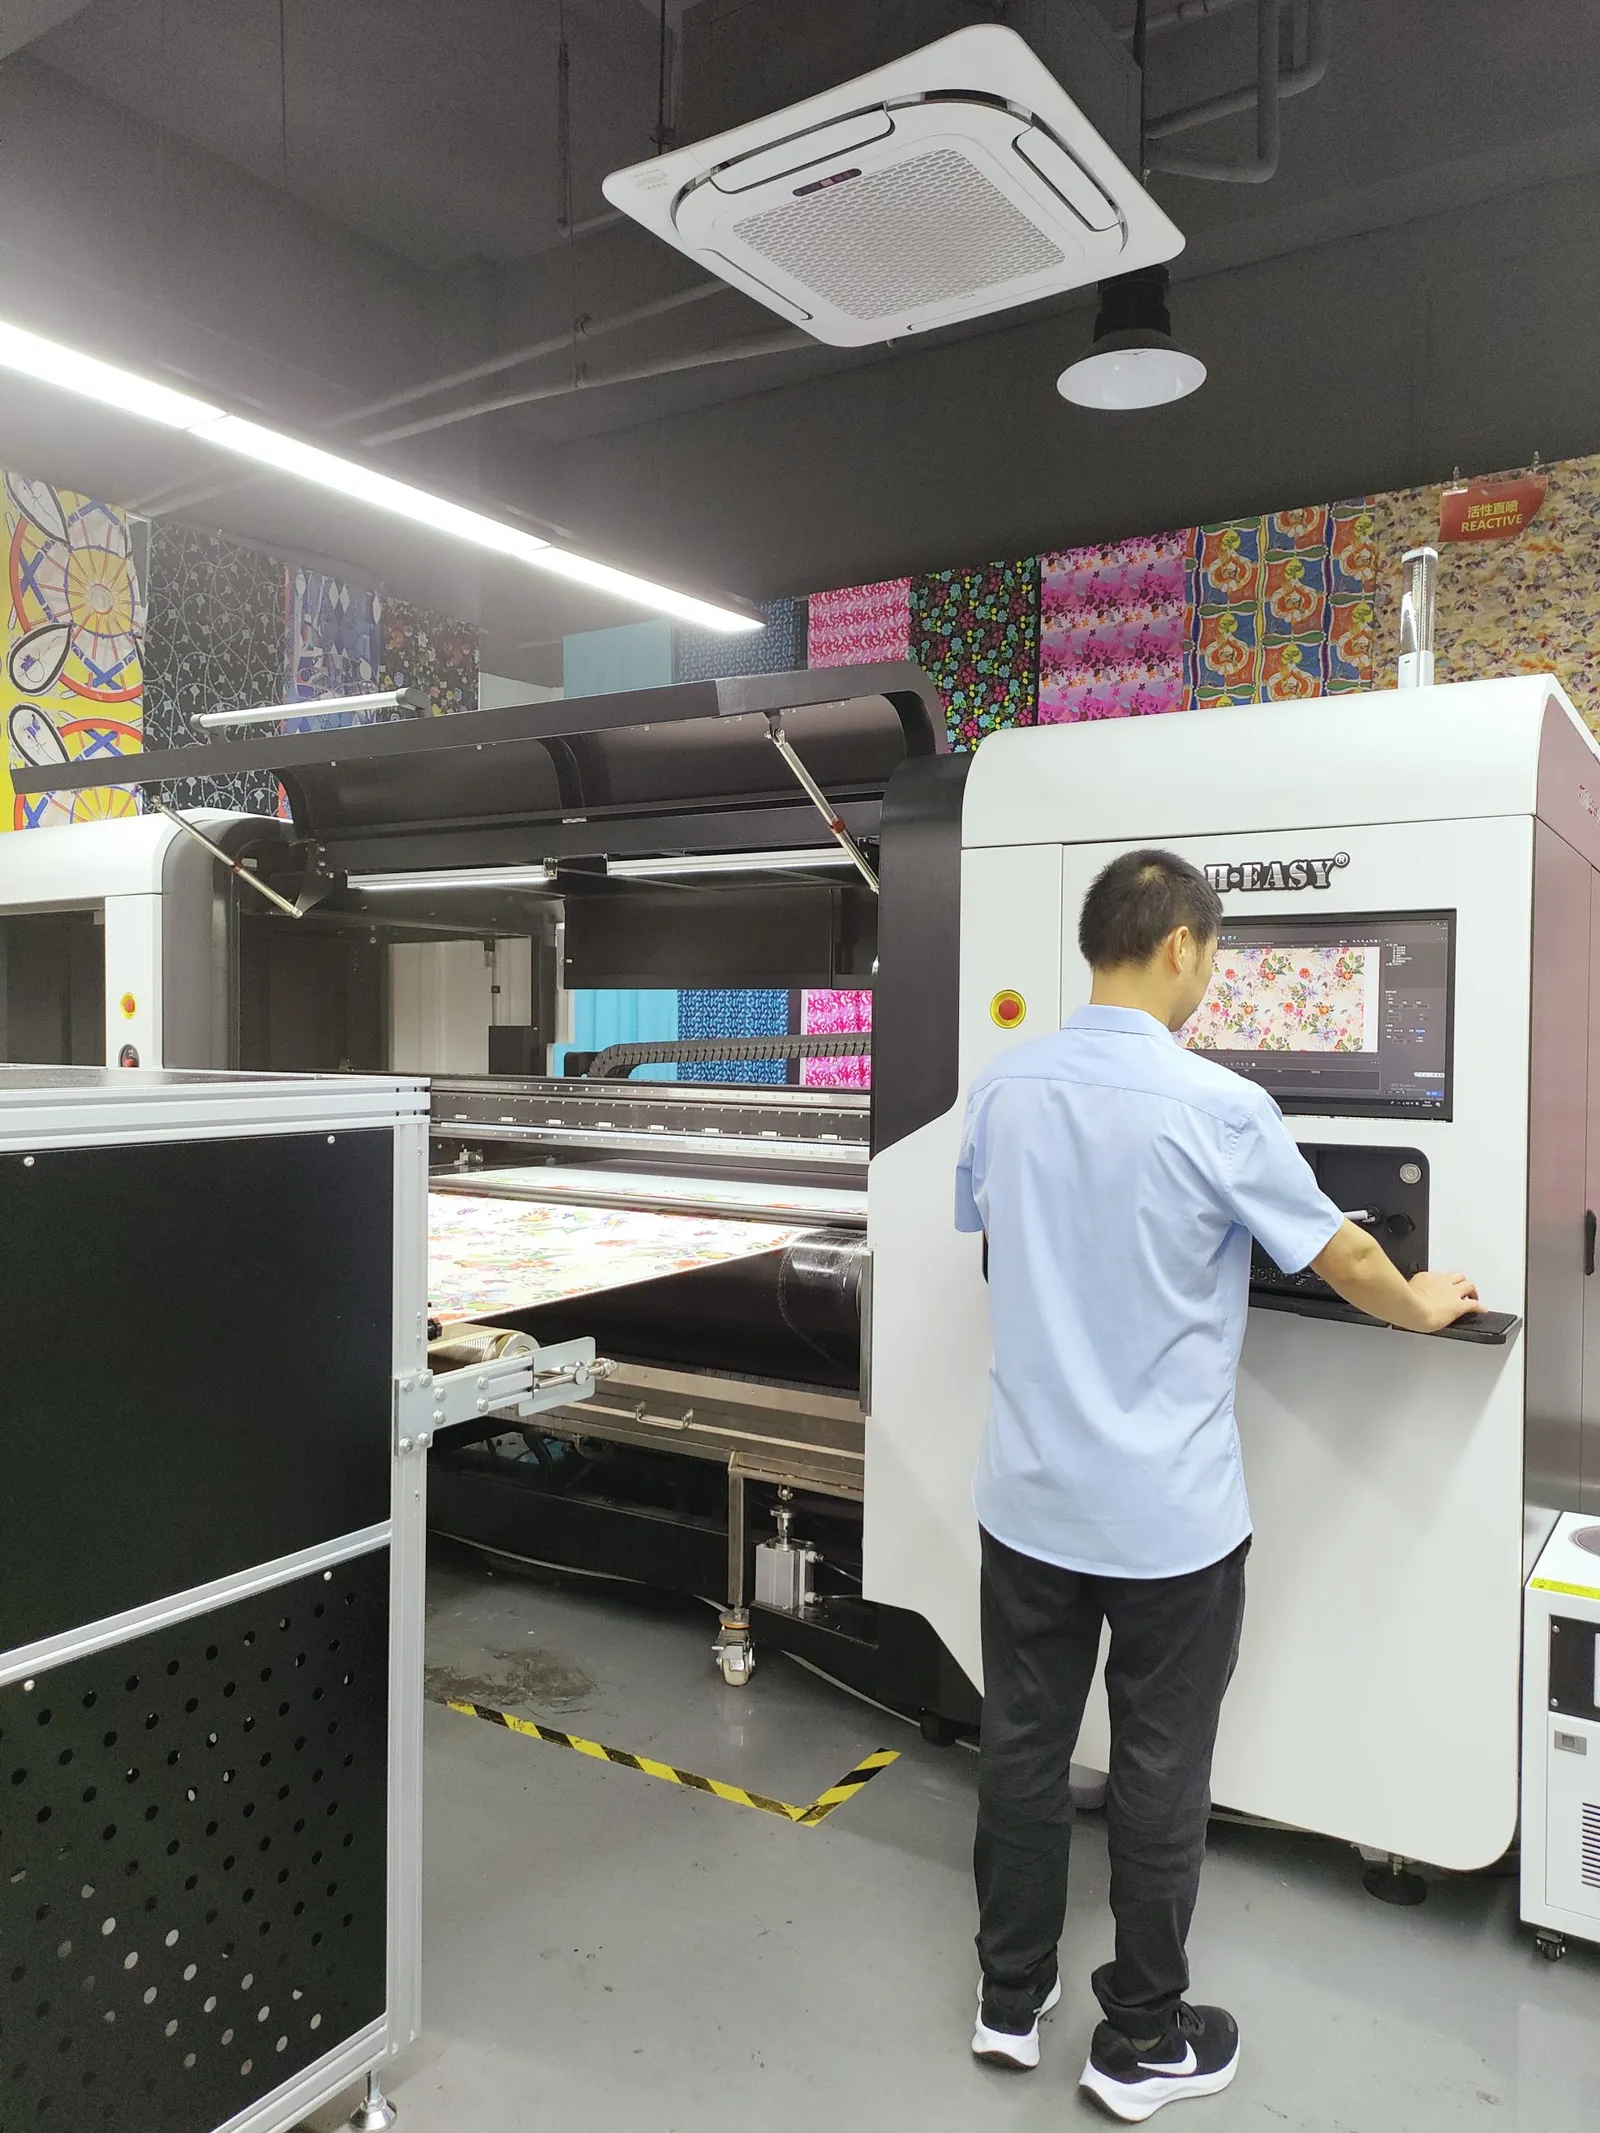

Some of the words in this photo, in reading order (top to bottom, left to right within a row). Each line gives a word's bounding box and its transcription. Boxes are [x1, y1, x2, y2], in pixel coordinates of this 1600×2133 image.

[1467, 499, 1518, 519] 活性直喷
[1461, 513, 1524, 533] REACTIVE
